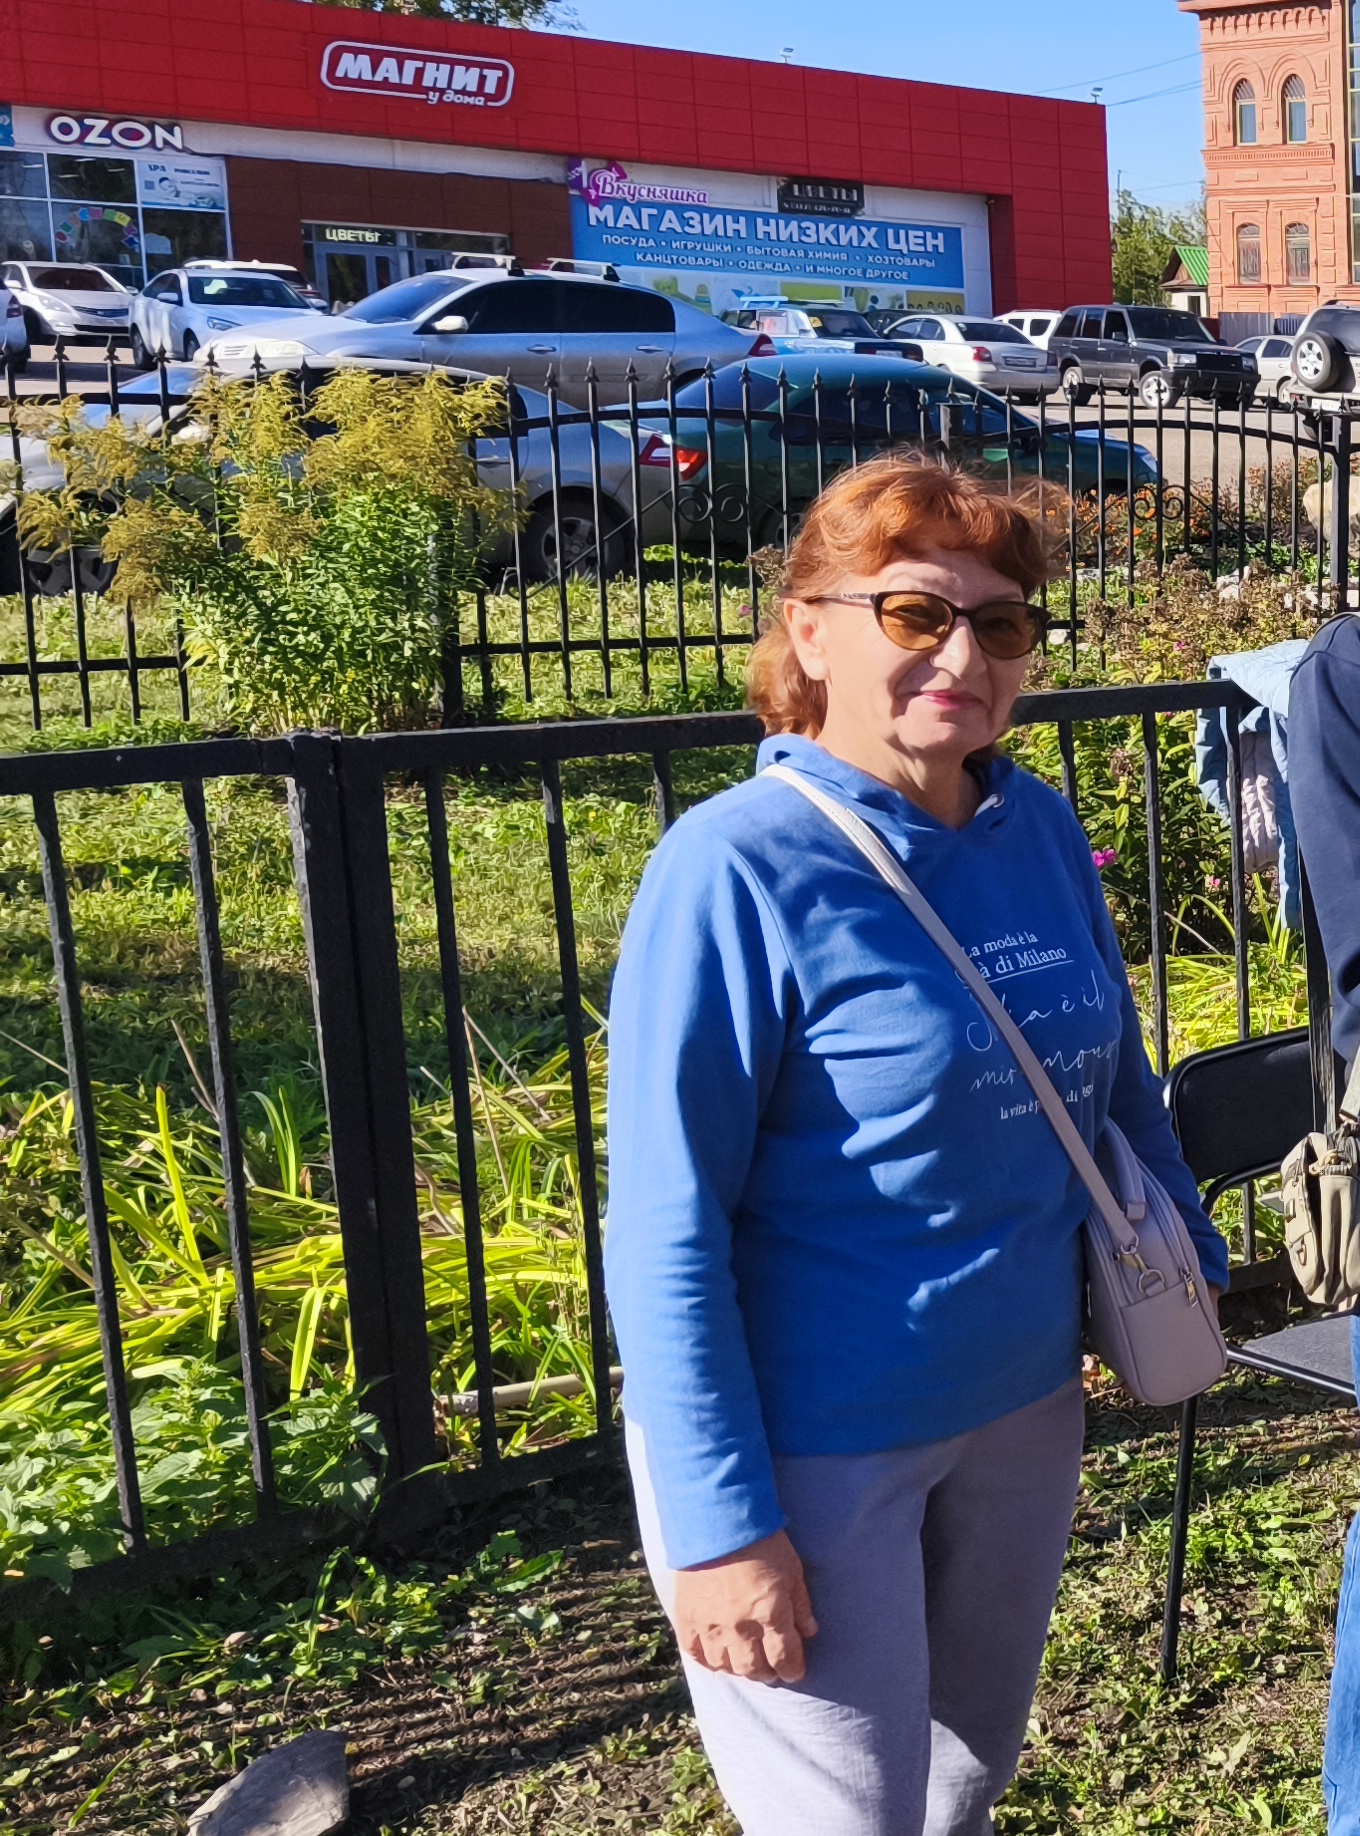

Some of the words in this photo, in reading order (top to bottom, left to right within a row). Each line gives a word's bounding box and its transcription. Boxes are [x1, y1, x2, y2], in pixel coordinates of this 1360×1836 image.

[335, 52, 503, 95] МАГНИТ
[427, 92, 440, 105] у
[443, 90, 485, 106] дома
[50, 115, 184, 150] OZON
[596, 170, 709, 205] Вкусняшка
[325, 228, 379, 243] ЦВЕТЫ
[588, 204, 747, 239] МАГАЗИН
[755, 217, 880, 249] НИЗКИХ
[887, 228, 945, 254] ЦЕН
[602, 234, 656, 248] ПОСУДА
[671, 240, 732, 253] ИГРУШКИ
[747, 245, 805, 258] БЫТОВАЯ
[808, 250, 848, 261] ХИМИЯ
[867, 254, 936, 268] ХОЗТОВАРЫ
[635, 252, 724, 268] КАНЦТОВАРЫ
[738, 259, 792, 273] ОДЕЖДА
[805, 264, 814, 273] И
[816, 265, 863, 277] МНОГОЕ
[865, 269, 909, 280] ДРУГОЕ
[984, 934, 1017, 953] moda
[995, 957, 1014, 974] di
[1016, 947, 1067, 969] Milano
